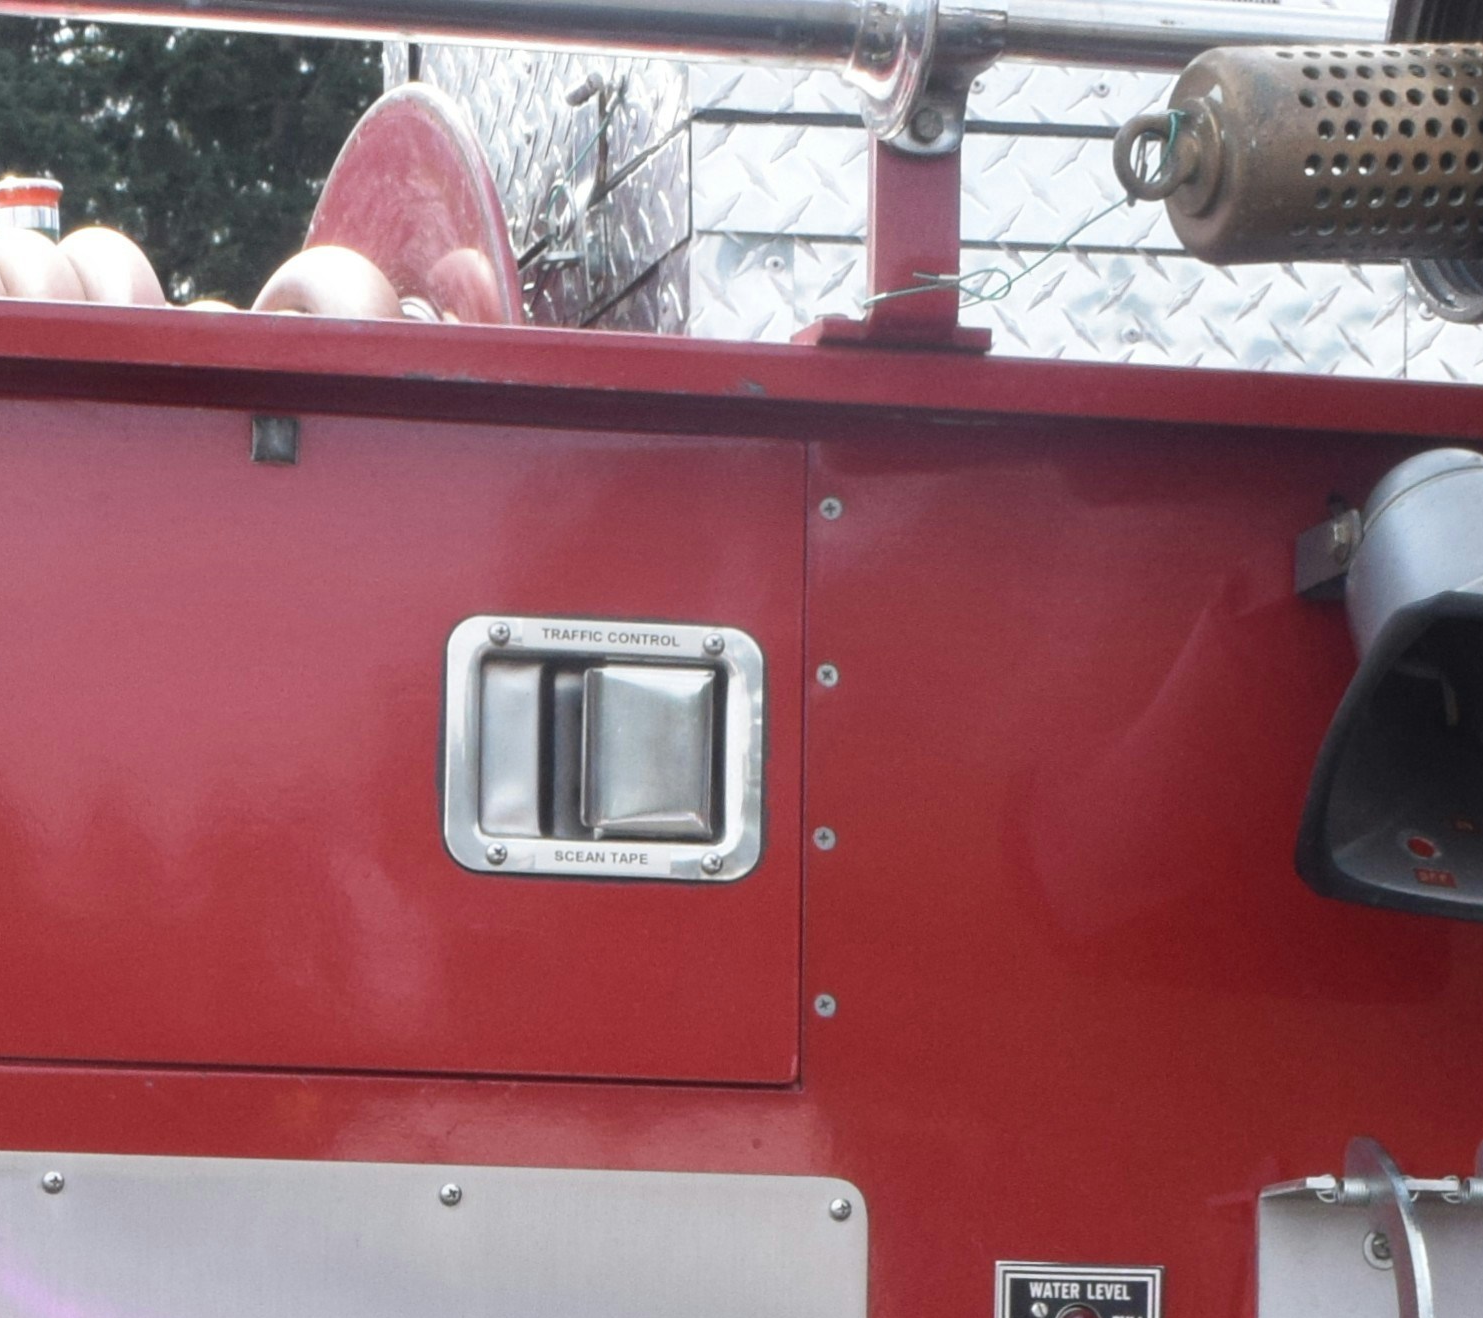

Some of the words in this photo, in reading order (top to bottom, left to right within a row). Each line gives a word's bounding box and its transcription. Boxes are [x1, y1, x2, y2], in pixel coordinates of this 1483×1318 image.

[542, 627, 604, 643] TRAFFIC
[608, 631, 680, 648] CONTROL
[555, 850, 606, 864] SCEAN
[610, 852, 649, 865] TAPE
[1029, 1282, 1080, 1299] WATER
[1087, 1283, 1131, 1300] LEVEL
